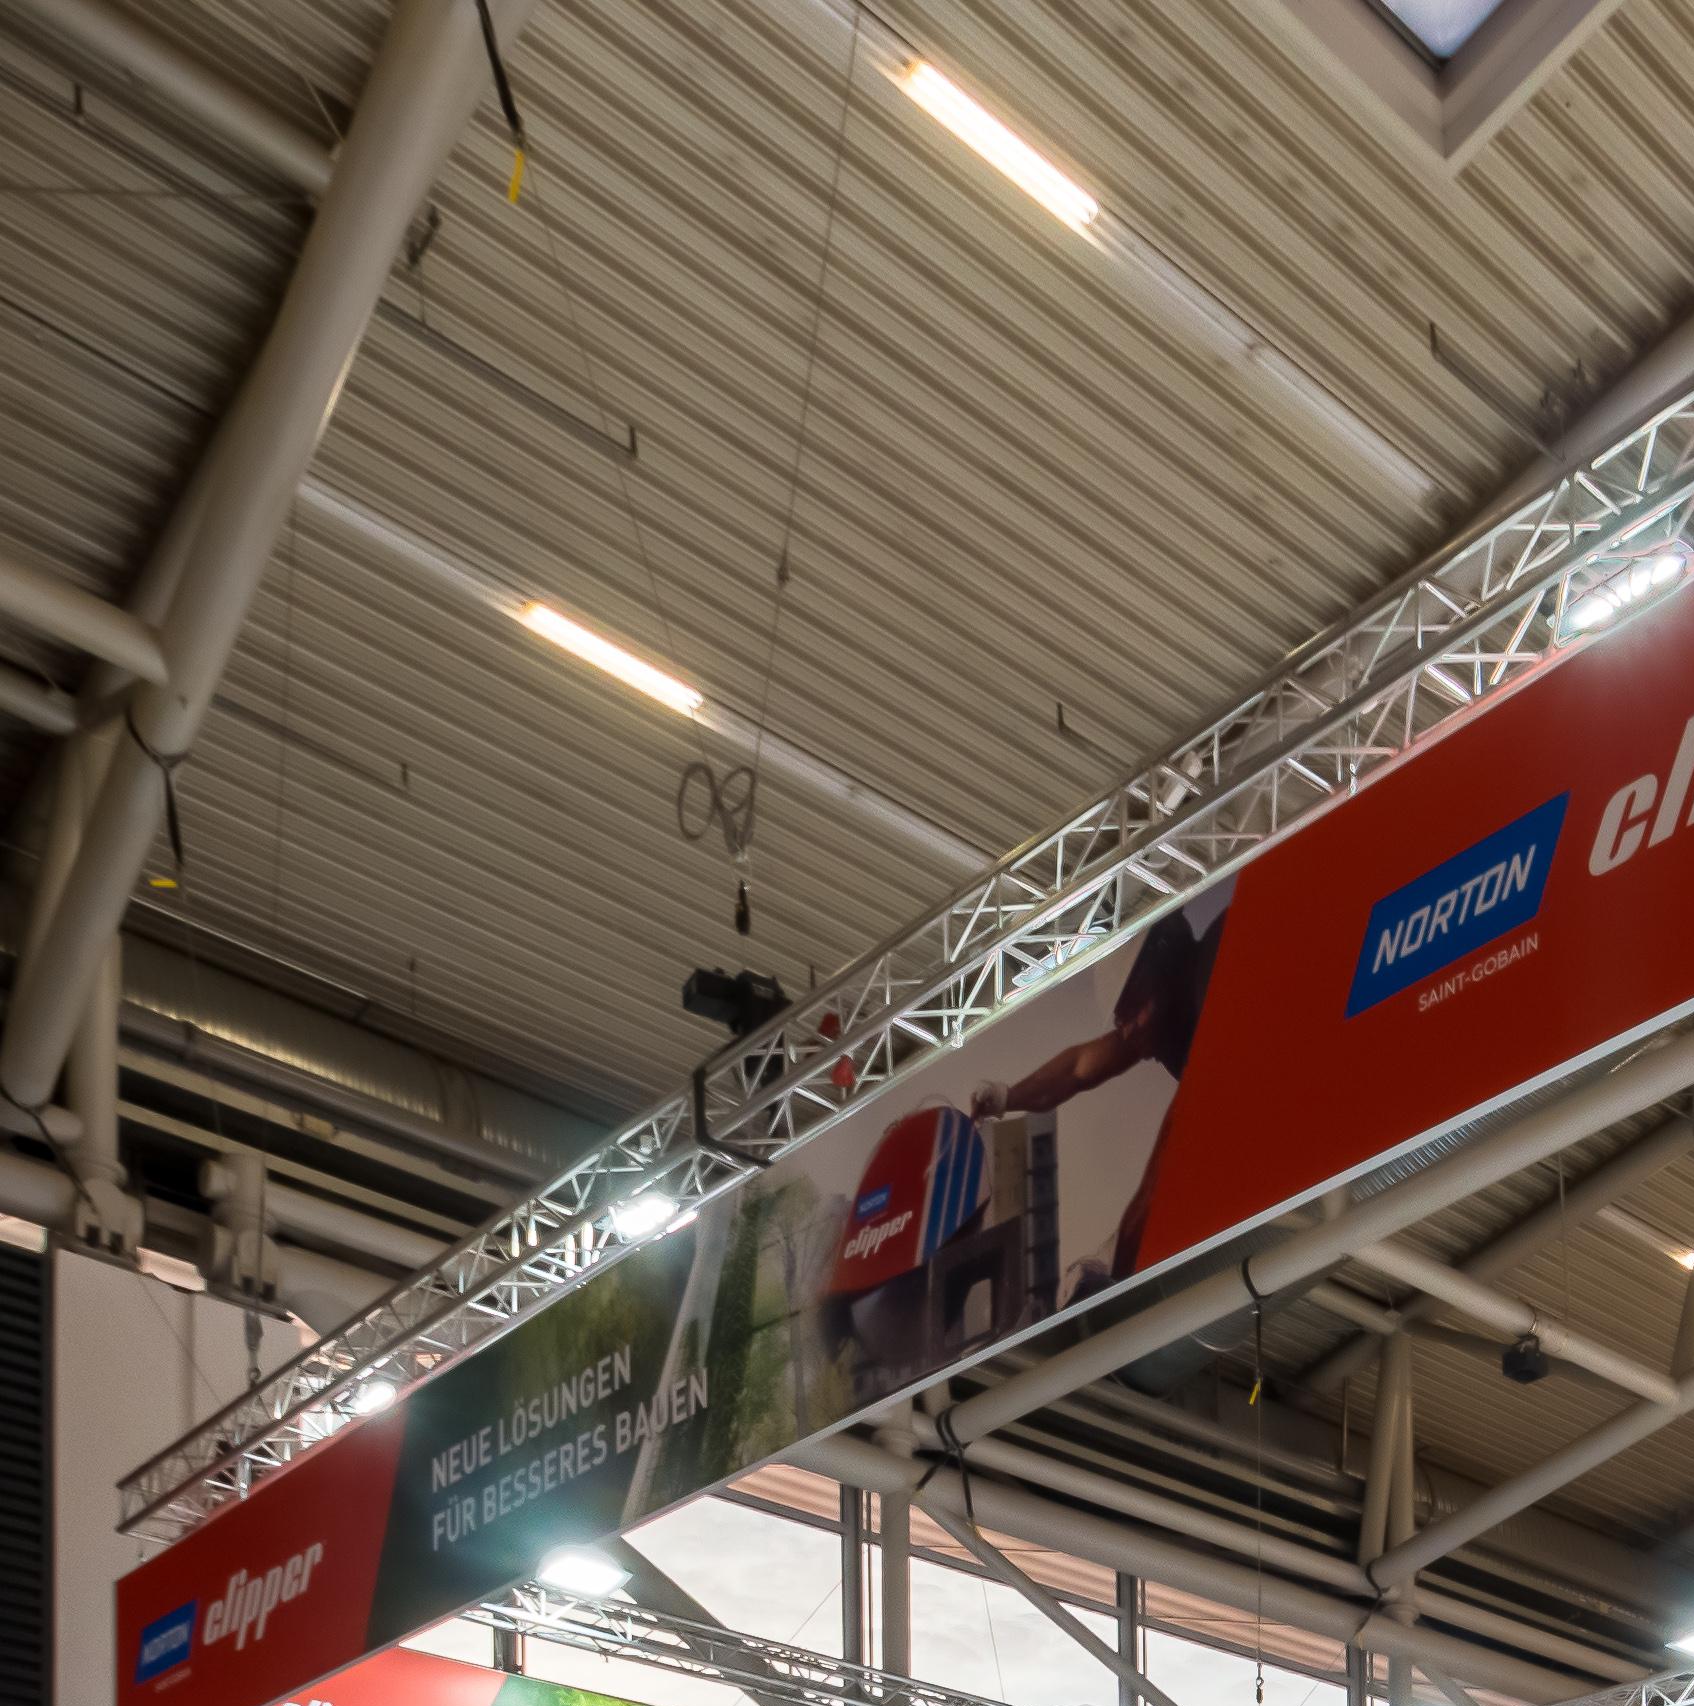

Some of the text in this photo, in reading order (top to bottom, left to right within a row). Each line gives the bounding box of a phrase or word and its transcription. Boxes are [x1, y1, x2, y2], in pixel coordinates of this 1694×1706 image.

[1372, 845, 1536, 973] NORTON
[1418, 934, 1539, 1011] SAINT-GOBAIN
[431, 1345, 632, 1493] NEUE LÖSUNGEN
[432, 1370, 708, 1551] FÜR BESSERES BAUEN
[204, 1542, 323, 1651] clipper
